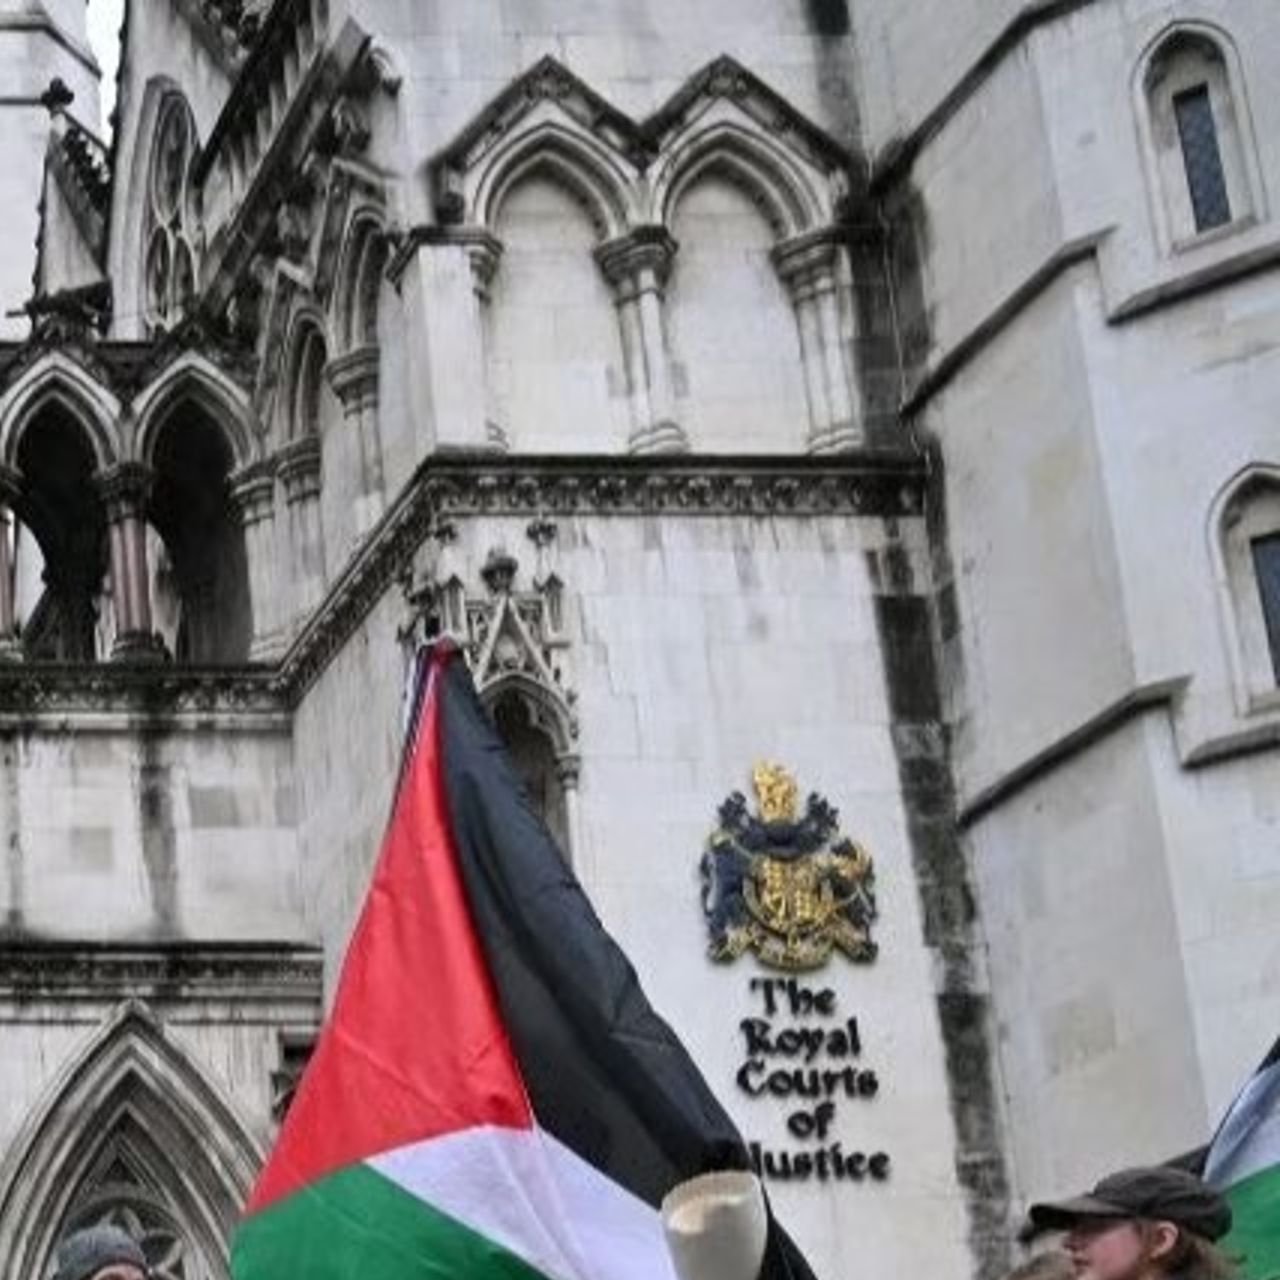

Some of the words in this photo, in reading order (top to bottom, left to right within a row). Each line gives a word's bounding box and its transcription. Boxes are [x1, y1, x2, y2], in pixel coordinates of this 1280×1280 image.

[750, 978, 836, 1017] The
[740, 1018, 861, 1063] Royal
[737, 1060, 878, 1099] Courts
[787, 1100, 835, 1139] of
